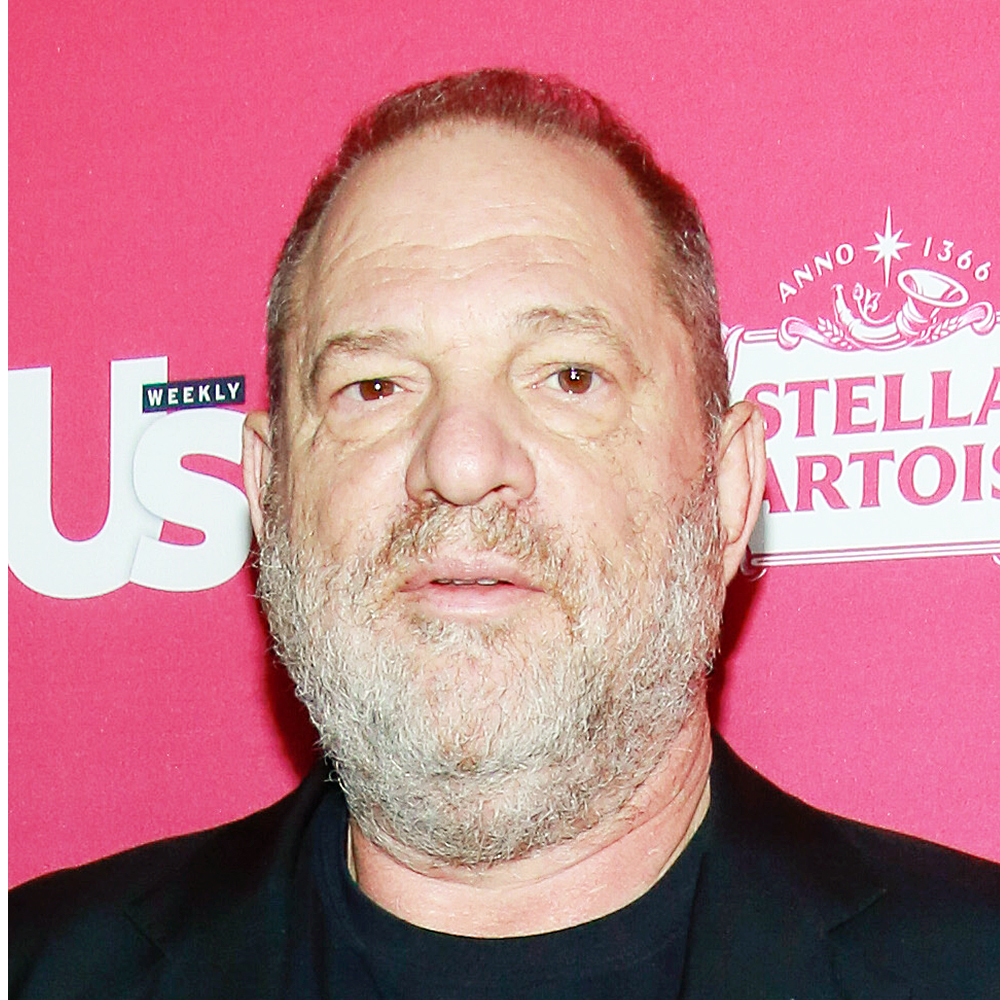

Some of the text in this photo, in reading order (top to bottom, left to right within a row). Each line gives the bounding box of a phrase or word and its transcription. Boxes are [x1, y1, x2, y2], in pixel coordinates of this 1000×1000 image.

[778, 236, 992, 304] ANNO 1366
[146, 381, 241, 407] WEEKLY
